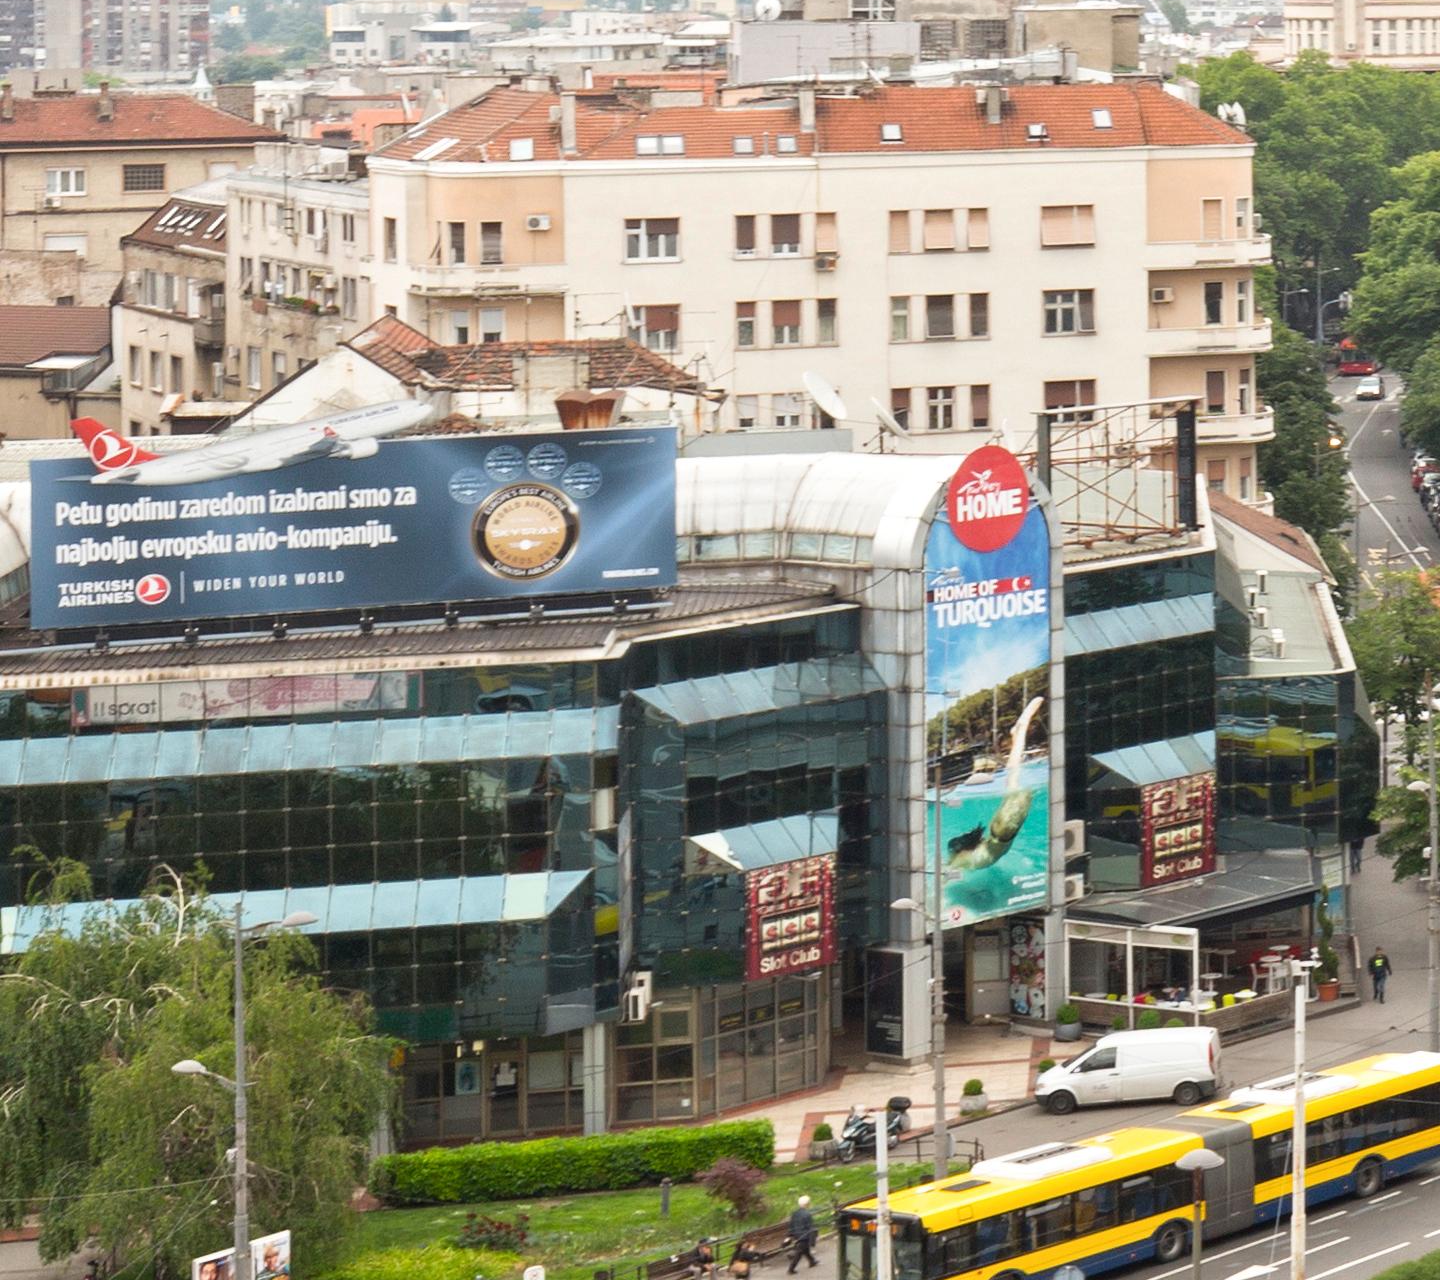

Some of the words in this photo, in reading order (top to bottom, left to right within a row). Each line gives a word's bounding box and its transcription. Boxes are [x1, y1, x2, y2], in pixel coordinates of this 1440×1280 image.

[55, 502, 102, 526] Petu
[105, 497, 176, 527] godinu
[179, 492, 266, 520] zaredom
[269, 485, 346, 513] izabrani
[349, 490, 391, 509] smo
[394, 486, 416, 506] za
[957, 488, 1023, 523] HOME
[55, 536, 138, 566] najbolju
[141, 530, 232, 561] evropsku
[235, 520, 398, 551] avio-kompaniju.
[58, 579, 135, 595] TURKISH
[193, 578, 241, 593] WIDEN
[249, 574, 287, 589] YOUR
[294, 571, 345, 586] WORLD
[934, 582, 978, 603] HOME
[978, 579, 999, 596] OF
[58, 592, 135, 608] AIRLINES
[933, 588, 1047, 628] TURQUOISE
[108, 700, 157, 722] sprat
[760, 953, 788, 974] Slot
[789, 946, 821, 966] Club
